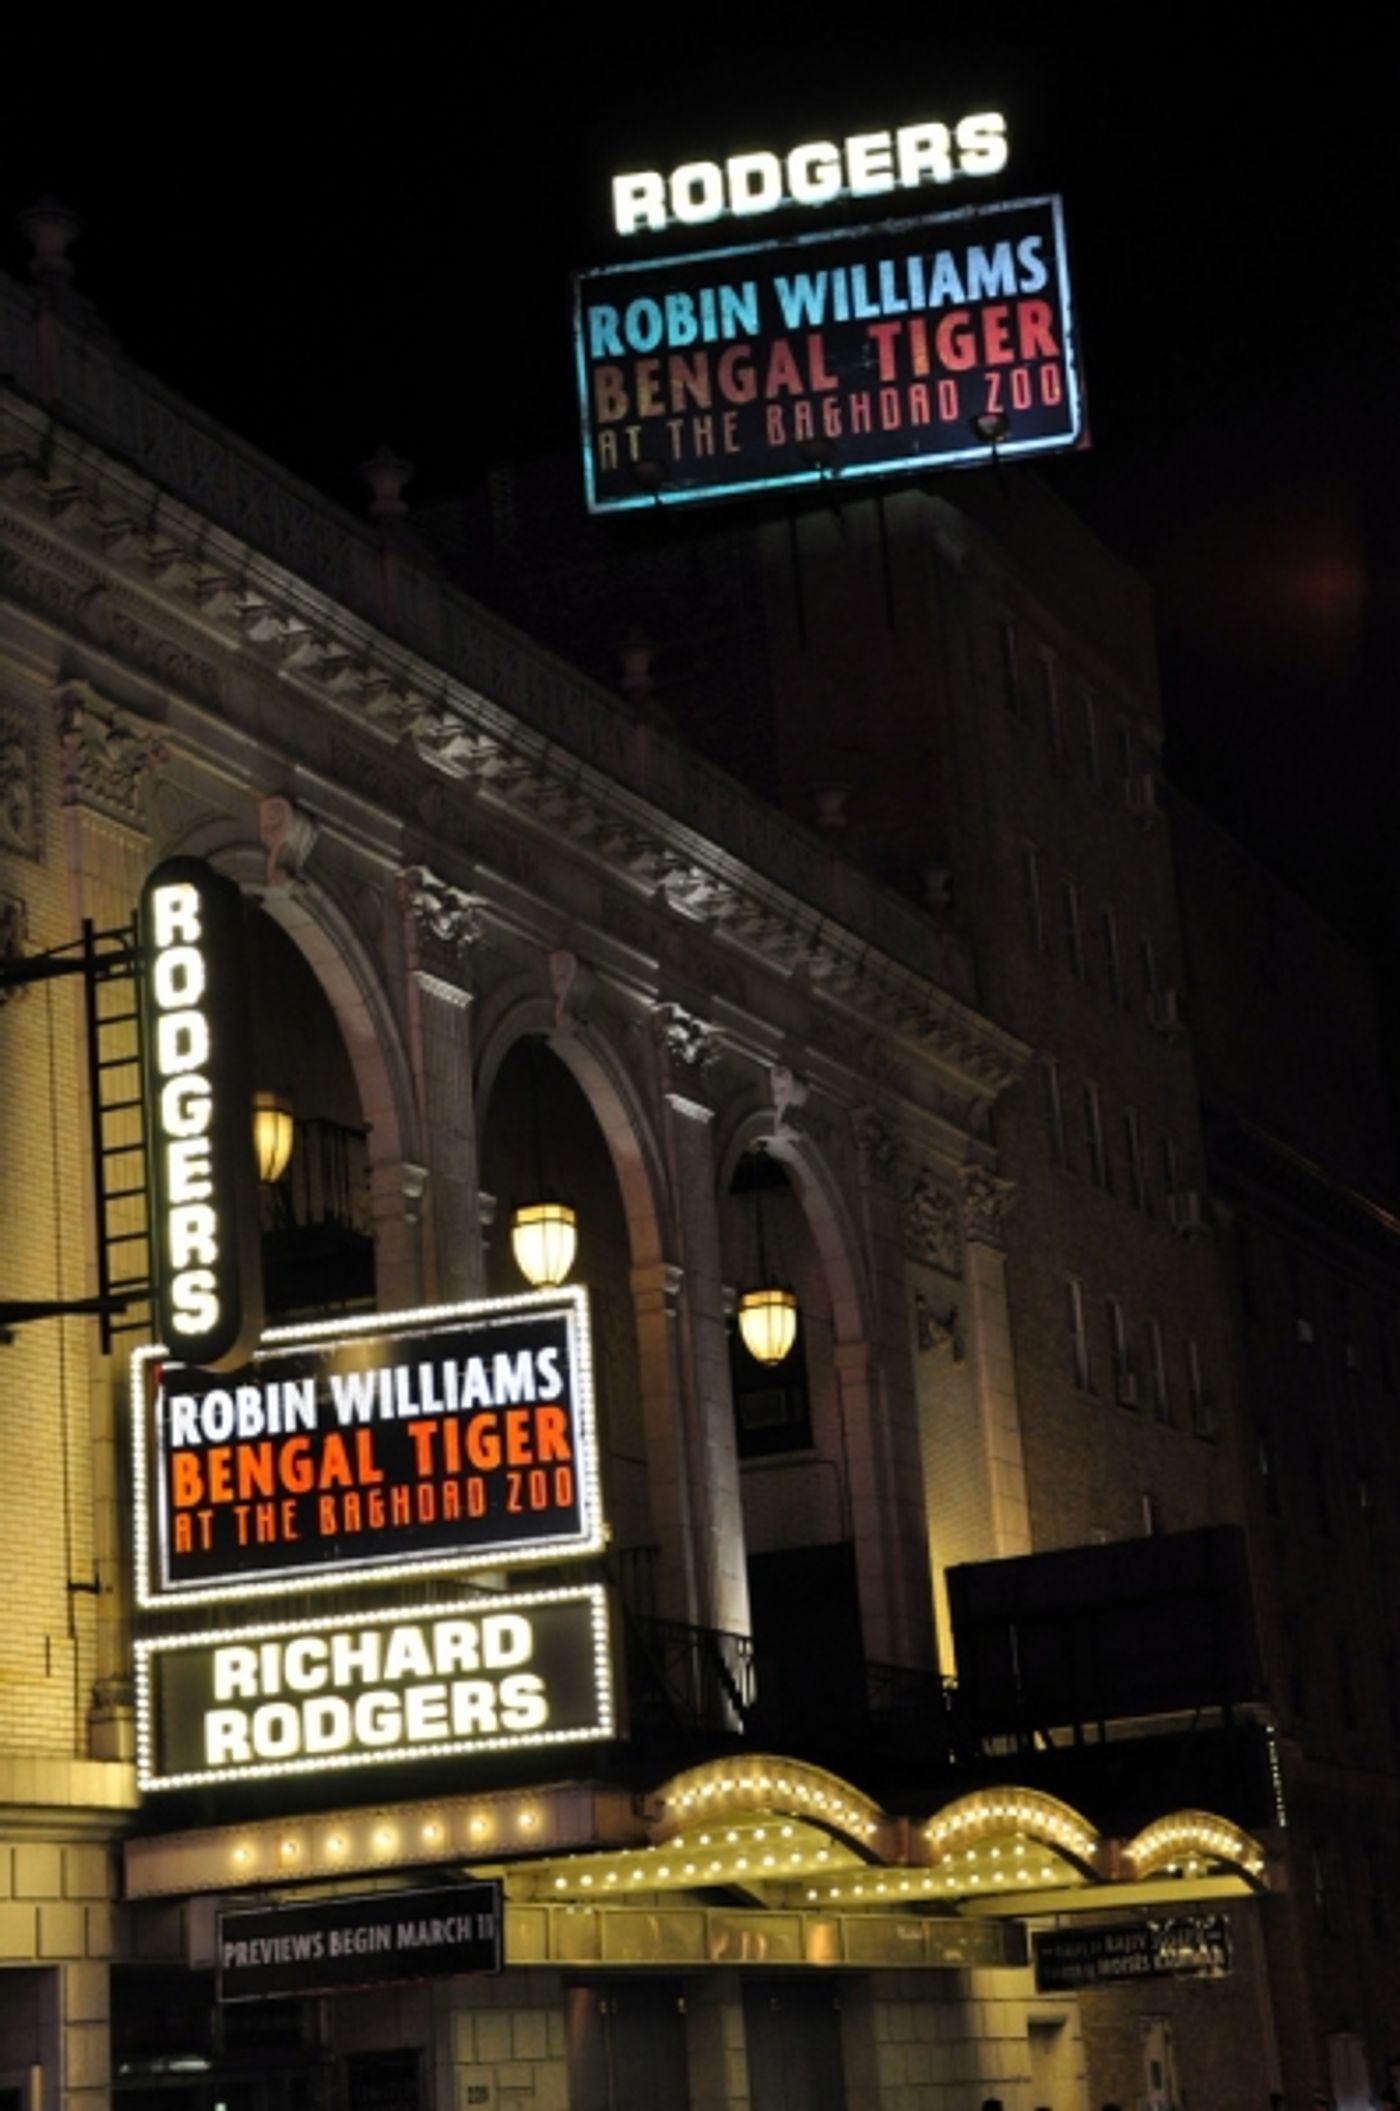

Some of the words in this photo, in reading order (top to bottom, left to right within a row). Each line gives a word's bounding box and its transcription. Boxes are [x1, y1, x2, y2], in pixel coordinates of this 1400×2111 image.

[612, 111, 1008, 234] RODGERS
[588, 282, 758, 358] ROBIN
[774, 236, 1048, 330] WILLIAMS
[593, 333, 839, 423] BENGAL
[867, 299, 1060, 382] TIGER
[600, 424, 642, 471] AT
[667, 411, 740, 459] THE
[766, 378, 958, 446] BAGHDAD
[985, 362, 1063, 413] ZOO
[153, 882, 220, 1335] RODGERS
[170, 1378, 318, 1447] ROBIN
[330, 1347, 564, 1425] WILLIAMS
[172, 1430, 383, 1507] BENGAL
[408, 1405, 572, 1476] TIGER
[175, 1510, 215, 1554] AT
[233, 1499, 298, 1546] THE
[319, 1476, 487, 1537] BAGHDAD
[506, 1466, 573, 1513] ZOO
[213, 1614, 534, 1701] RICHARD
[203, 1673, 550, 1766] RODGERS
[223, 1931, 324, 1968] PREVIEWS
[329, 1924, 391, 1957] BEGIN
[397, 1914, 471, 1949] MARCH
[477, 1913, 495, 1940] 11
